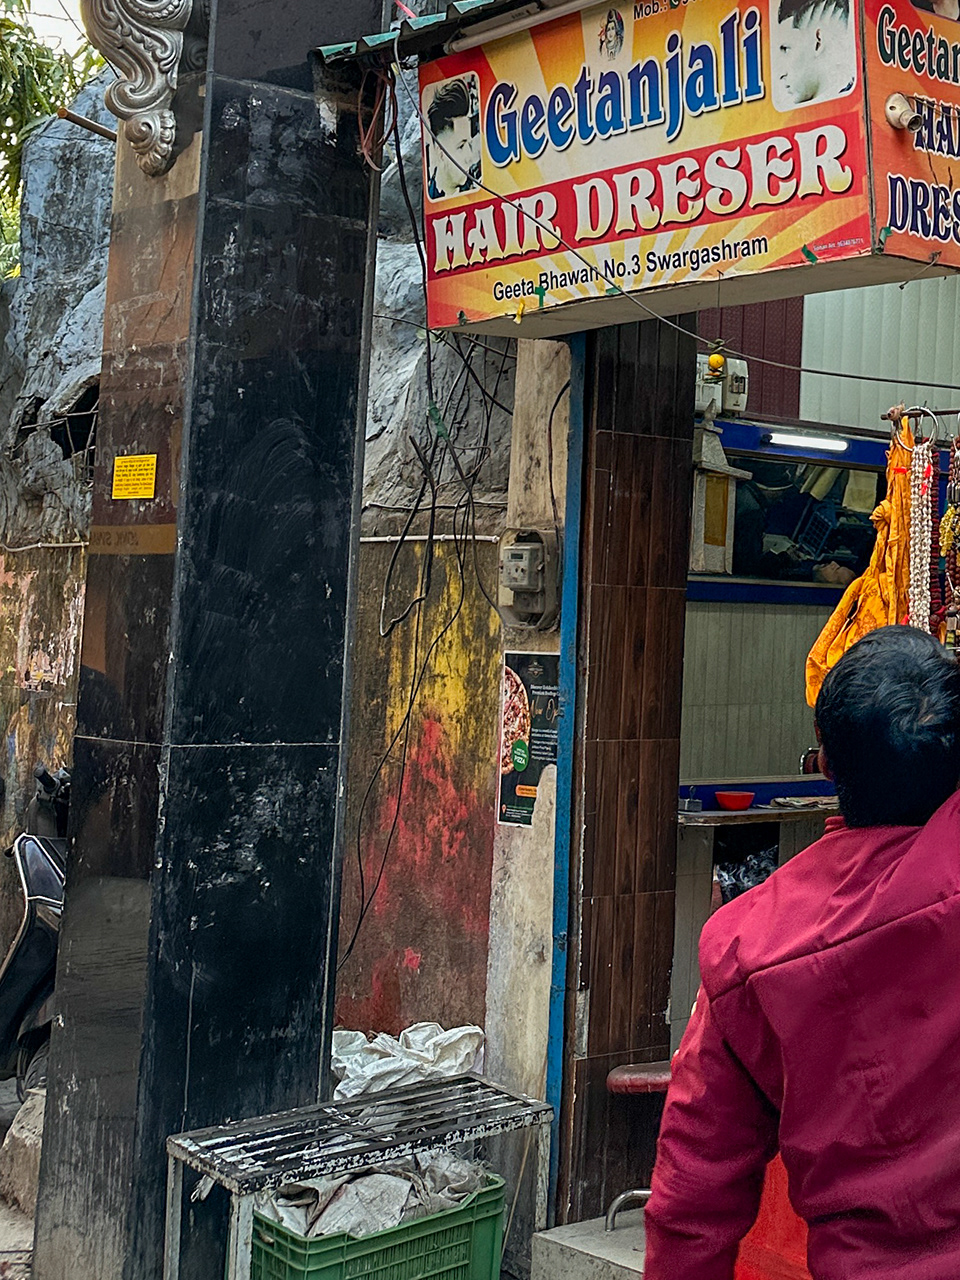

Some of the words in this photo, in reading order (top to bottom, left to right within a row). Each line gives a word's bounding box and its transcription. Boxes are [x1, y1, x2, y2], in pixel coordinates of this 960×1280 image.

[633, 0, 667, 20] Mob.:
[485, 7, 765, 168] Geetanjali
[432, 191, 561, 273] HAIR
[573, 124, 853, 242] DRESER
[493, 277, 535, 301] Geeta
[538, 266, 599, 291] Bhawan
[604, 257, 641, 280] No.3
[646, 236, 769, 271] Swargashram
